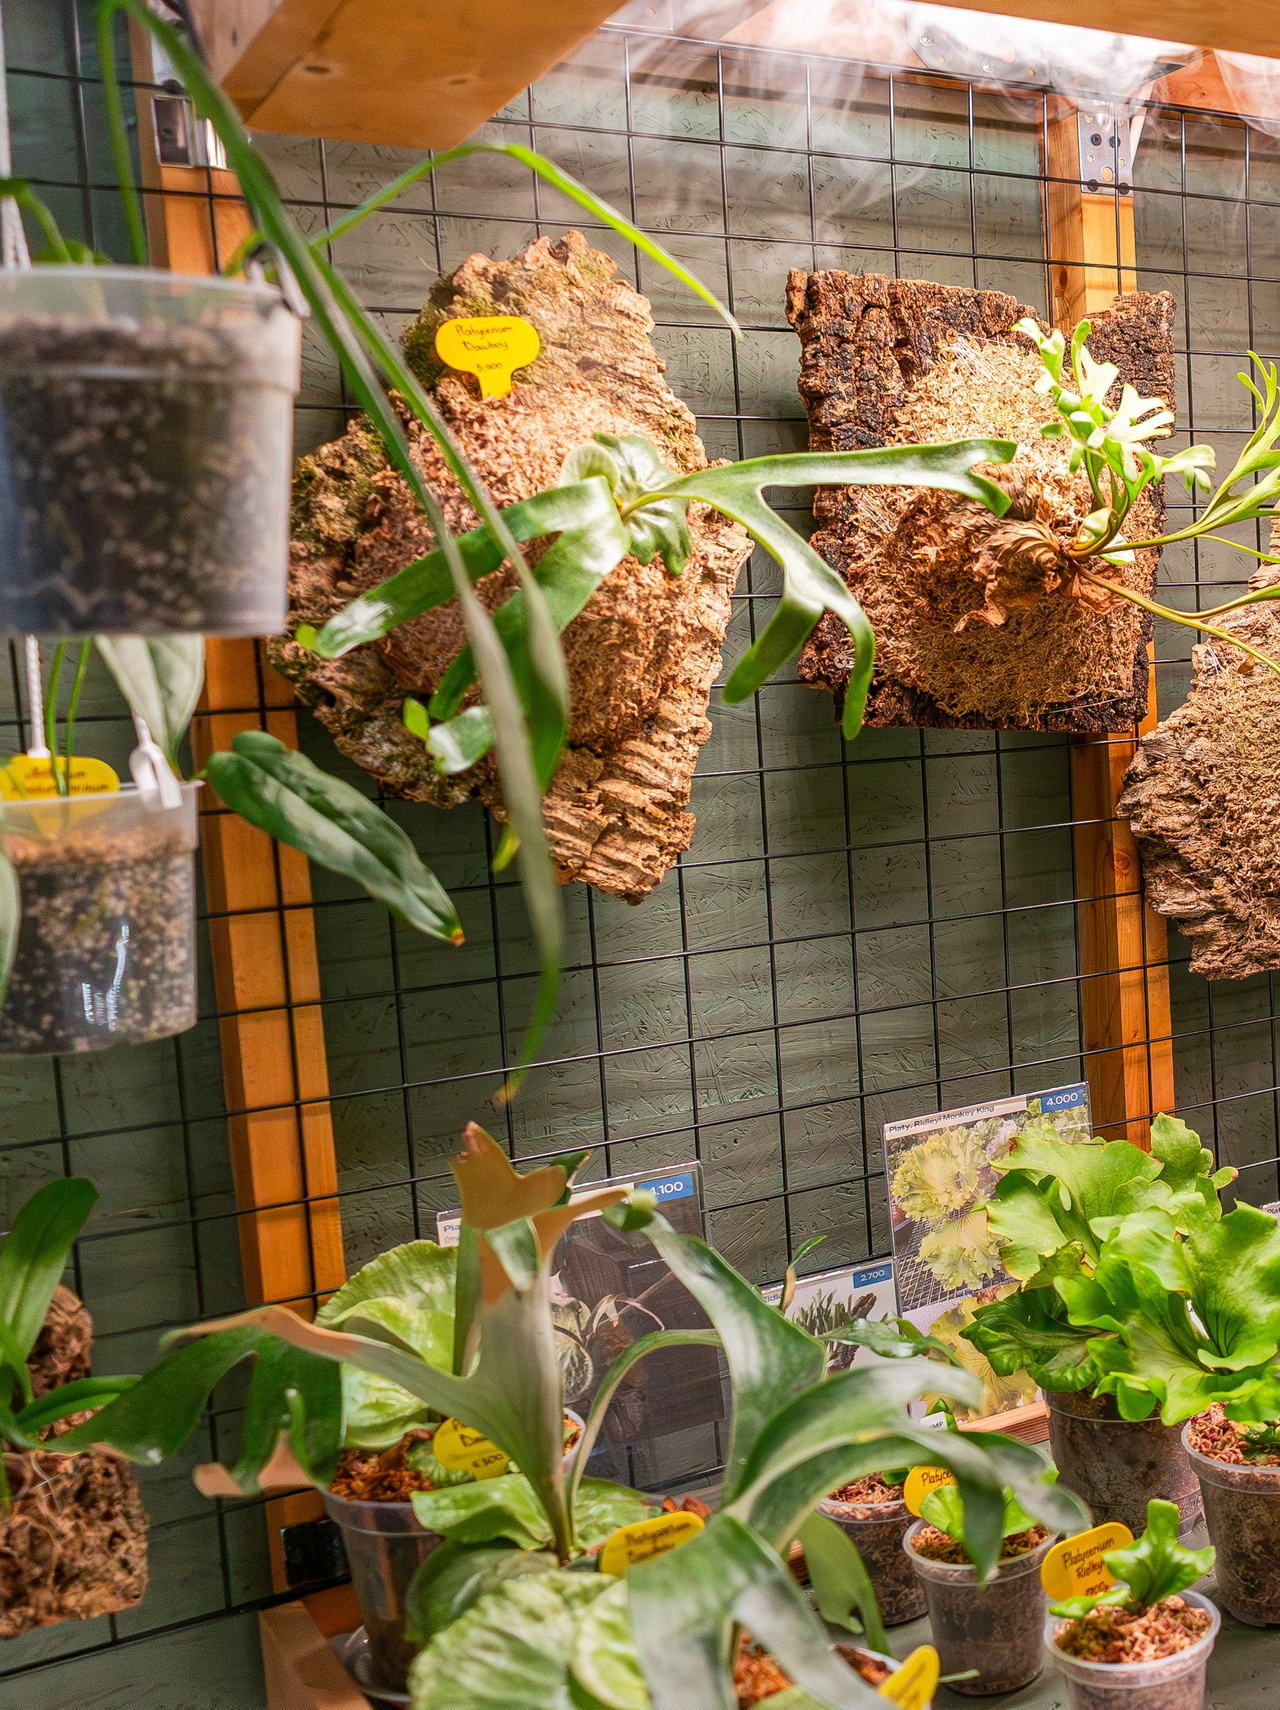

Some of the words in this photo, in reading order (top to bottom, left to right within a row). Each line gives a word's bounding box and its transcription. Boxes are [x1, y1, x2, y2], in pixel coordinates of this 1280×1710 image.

[1046, 1092, 1079, 1106] 4.000
[889, 1123, 914, 1134] Platy.
[914, 1115, 942, 1128] Ridleyi
[943, 1108, 976, 1122] Monkey
[976, 1104, 995, 1116] King
[650, 1181, 684, 1196] 4.100
[444, 1224, 460, 1233] Pla
